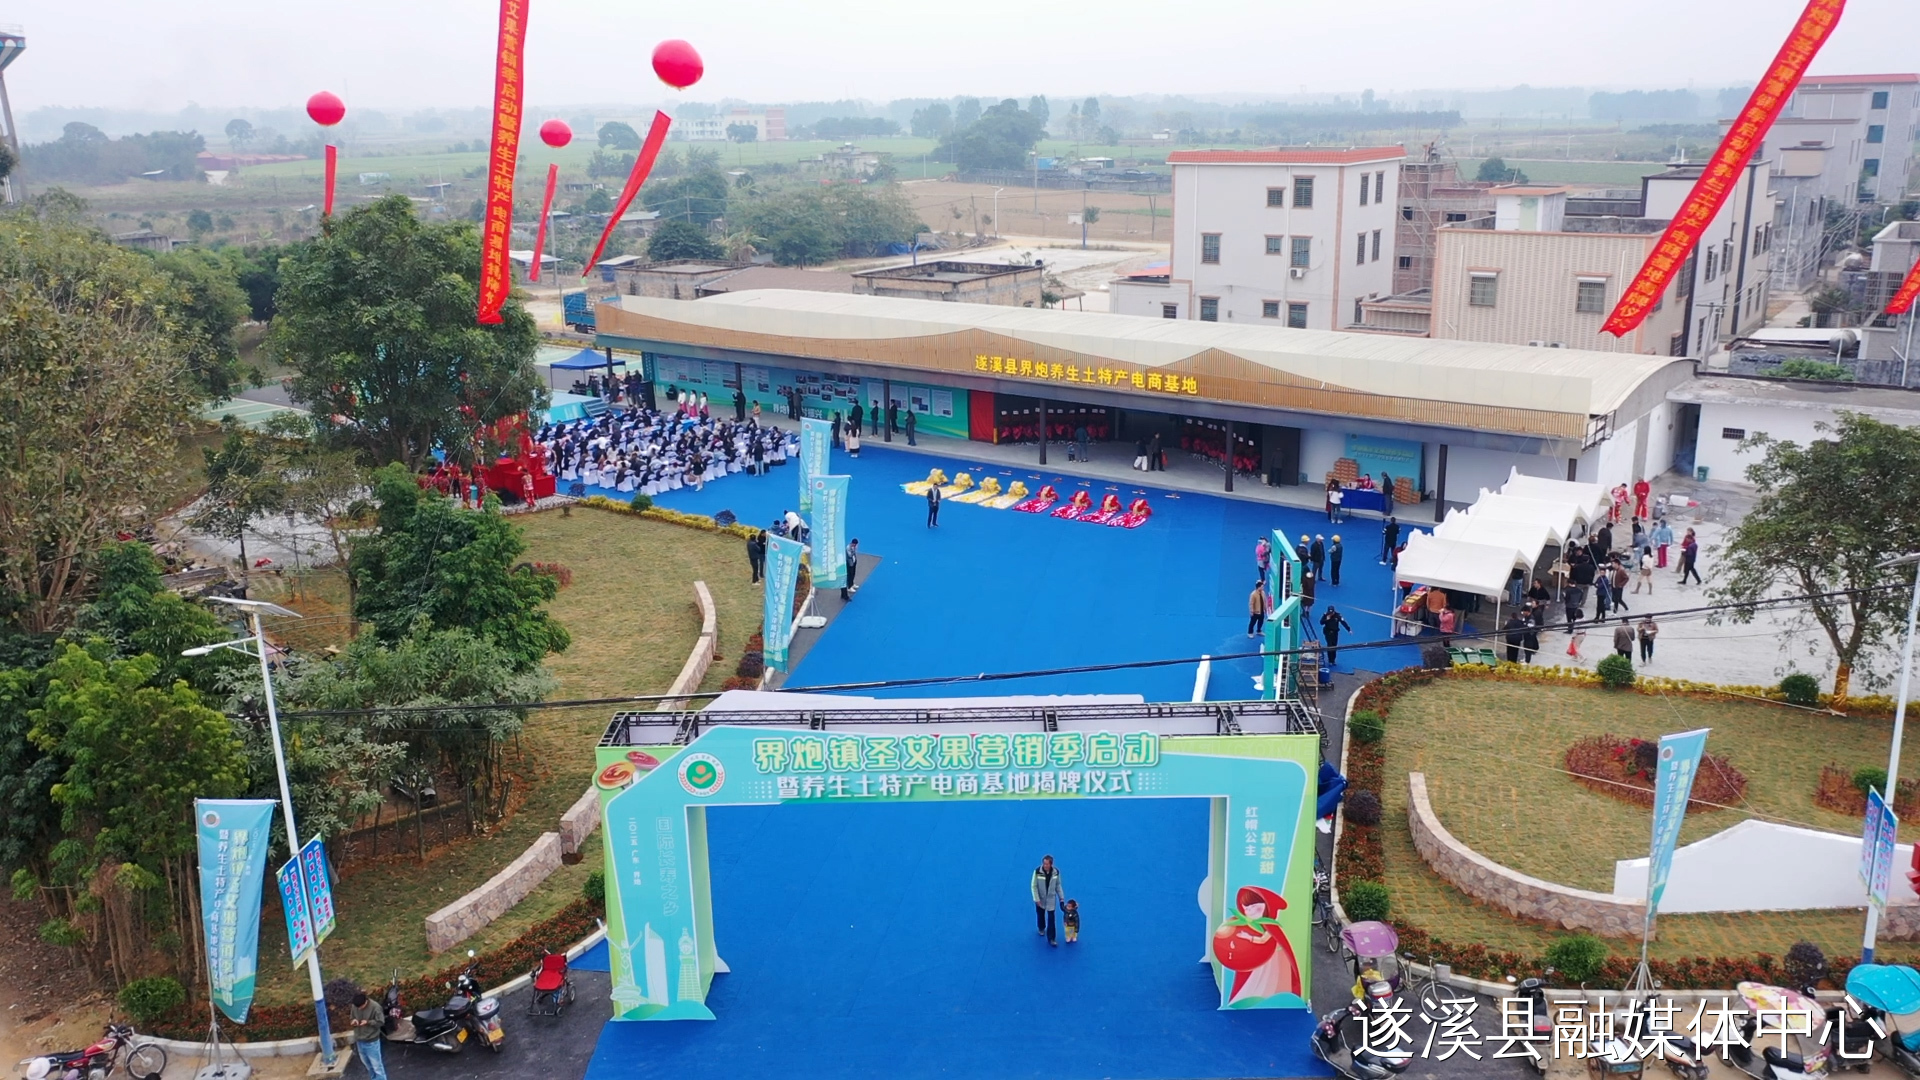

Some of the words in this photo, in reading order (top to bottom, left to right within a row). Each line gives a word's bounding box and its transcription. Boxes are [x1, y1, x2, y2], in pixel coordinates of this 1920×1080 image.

[975, 354, 1198, 394] 遂溪县界炮养生土特产电商基地
[753, 732, 1161, 773] 界炮镇圣女果营销季启动
[777, 769, 1132, 799] 暨养生土特产电商基地揭牌仪式
[1244, 806, 1259, 857] 红帽公主
[656, 816, 679, 917] 国际长寿之乡
[1259, 831, 1276, 875] 初恋甜
